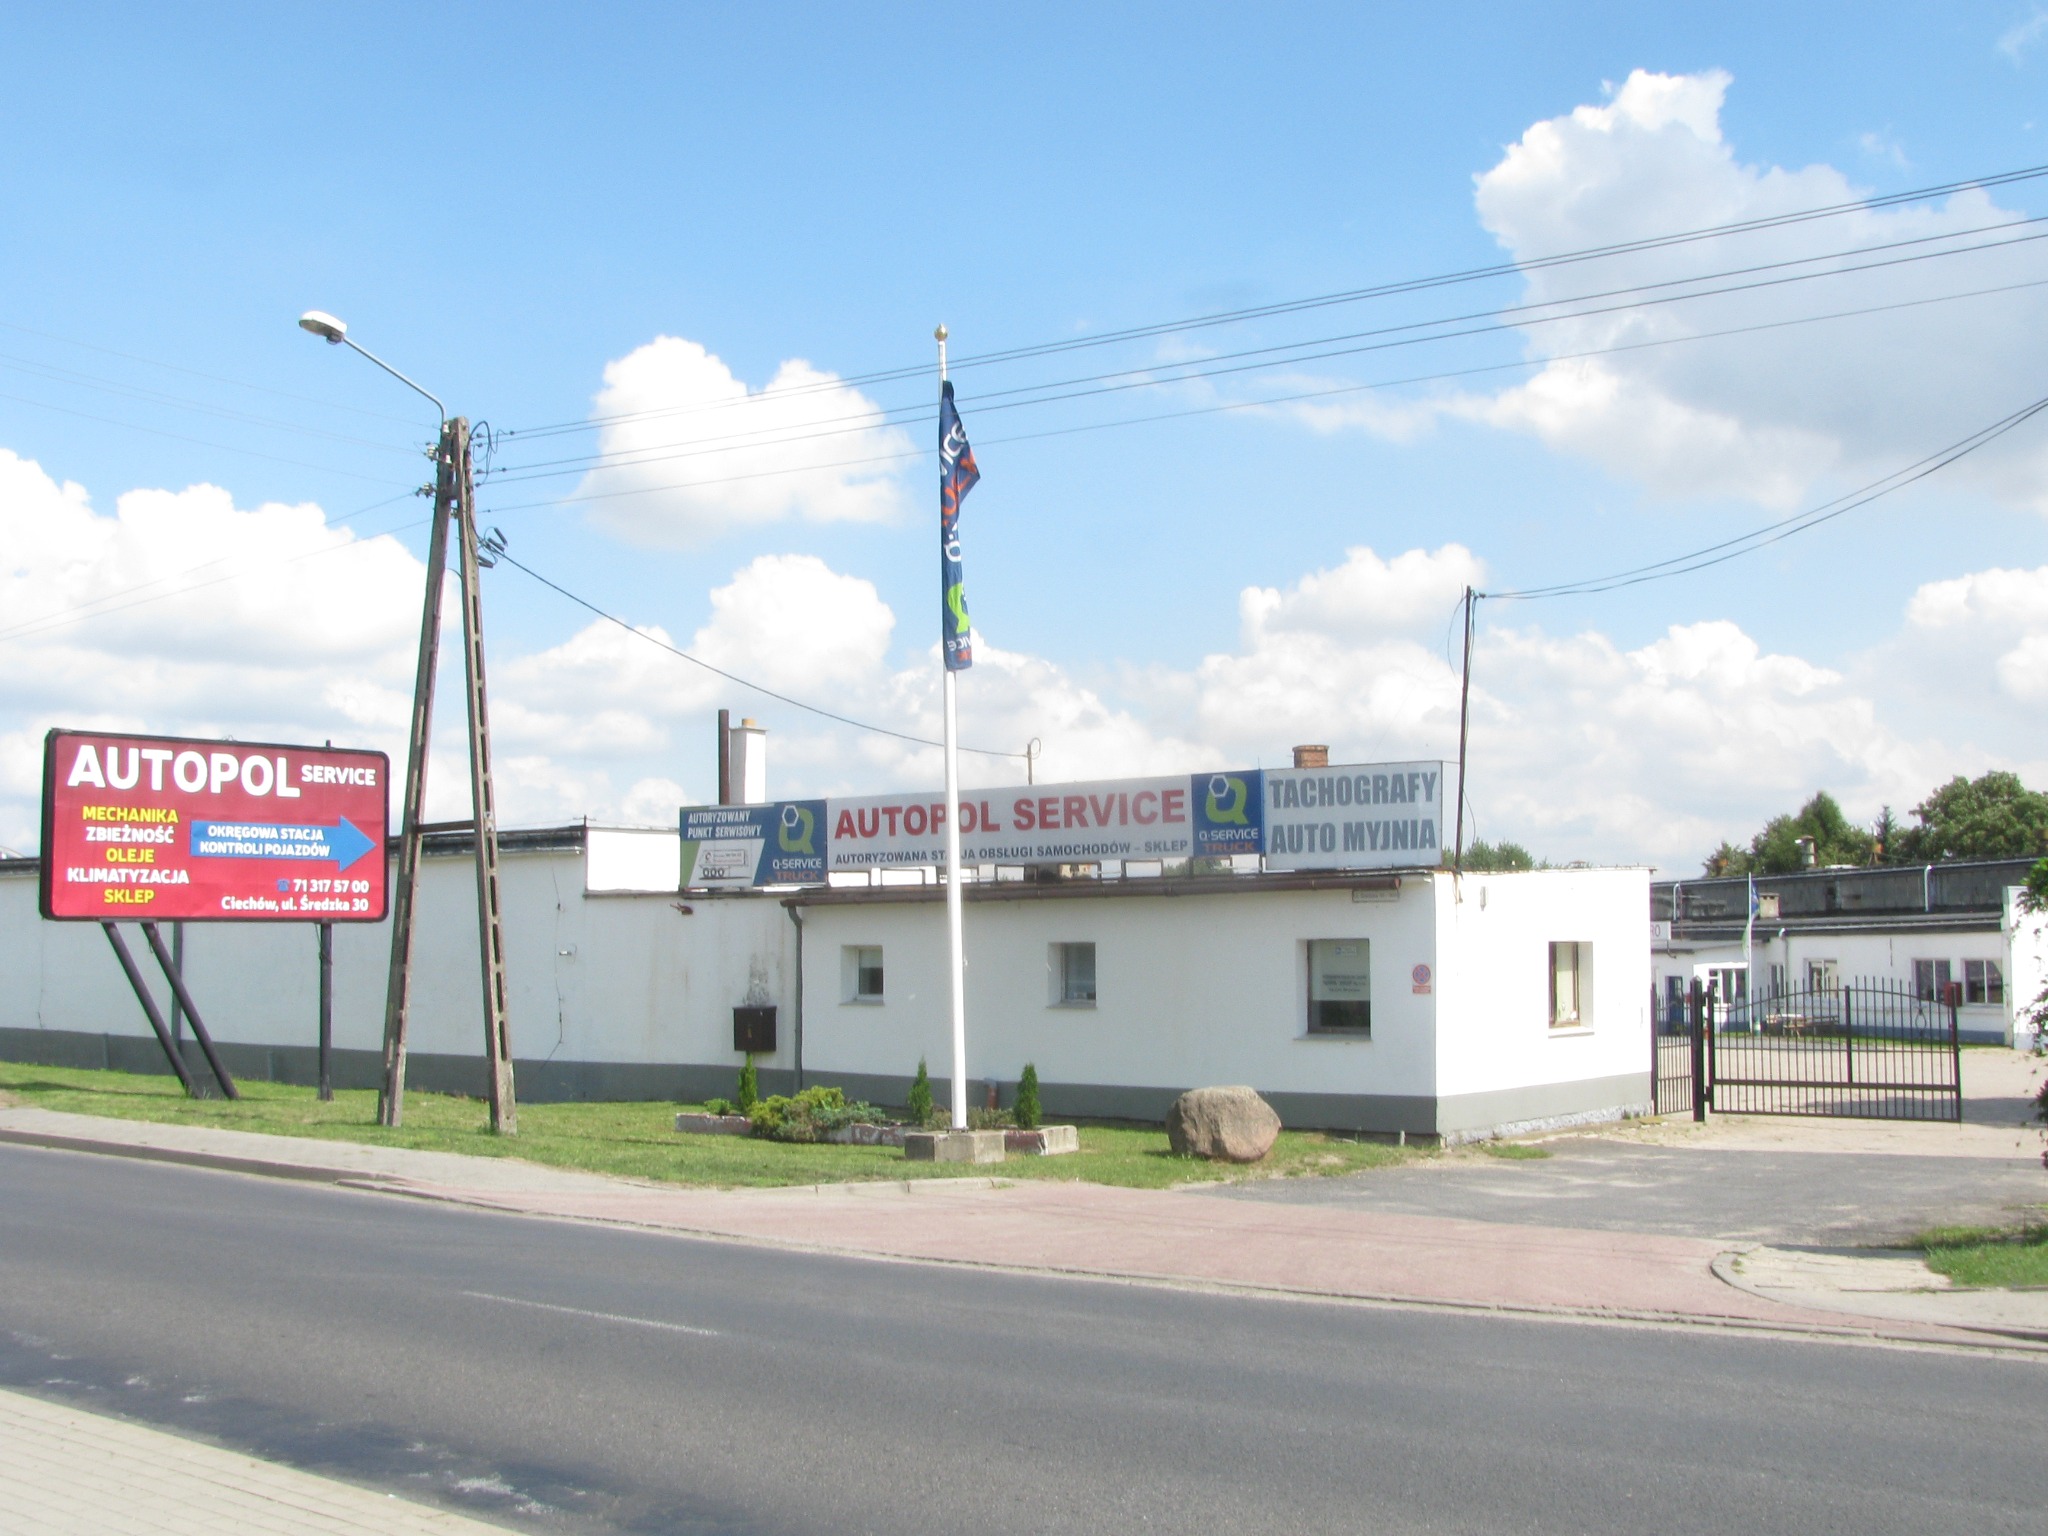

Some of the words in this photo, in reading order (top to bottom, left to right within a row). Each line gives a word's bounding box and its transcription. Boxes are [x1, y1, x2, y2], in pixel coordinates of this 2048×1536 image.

[67, 744, 300, 798] AUTOPOL
[301, 765, 376, 786] SERVICE
[1269, 772, 1436, 809] TACHOGRAFY
[83, 806, 178, 823] MECHANIKA
[688, 811, 751, 824] AUTORYZOWANY
[835, 801, 1000, 839] AUTOPOL
[1013, 789, 1185, 830] SERVICE
[86, 824, 174, 843] ZBIEŻNOŚĆ
[208, 825, 278, 841] OKRĘGOWA
[281, 828, 323, 841] STACJA
[688, 827, 712, 838] PUNKT
[715, 825, 761, 838] SERWISOWY
[1271, 823, 1336, 854] AUTO
[1344, 819, 1436, 852] MYJNIA
[200, 842, 263, 855] KONTROLI
[265, 842, 330, 857] POJAZDÓW
[836, 851, 927, 865] AUTORYZOWANA
[932, 849, 975, 861] STJA
[979, 846, 1032, 859] OBSŁUGI
[1037, 840, 1130, 856] SAMOCHODÓW
[1145, 840, 1188, 852] SKLEP
[1204, 841, 1255, 852] TRUCK
[106, 848, 154, 863] OLEJE
[67, 868, 189, 885] KLIMATYZACJA
[774, 871, 818, 880] TRUCK
[294, 879, 308, 892] 71
[310, 880, 331, 893] 317
[333, 880, 350, 893] 57
[352, 880, 369, 893] 00
[104, 889, 154, 904] SKLEP
[222, 896, 279, 911] Ciechów,
[281, 897, 298, 911] ul.
[300, 895, 349, 912] Średzka
[352, 898, 368, 912] 30
